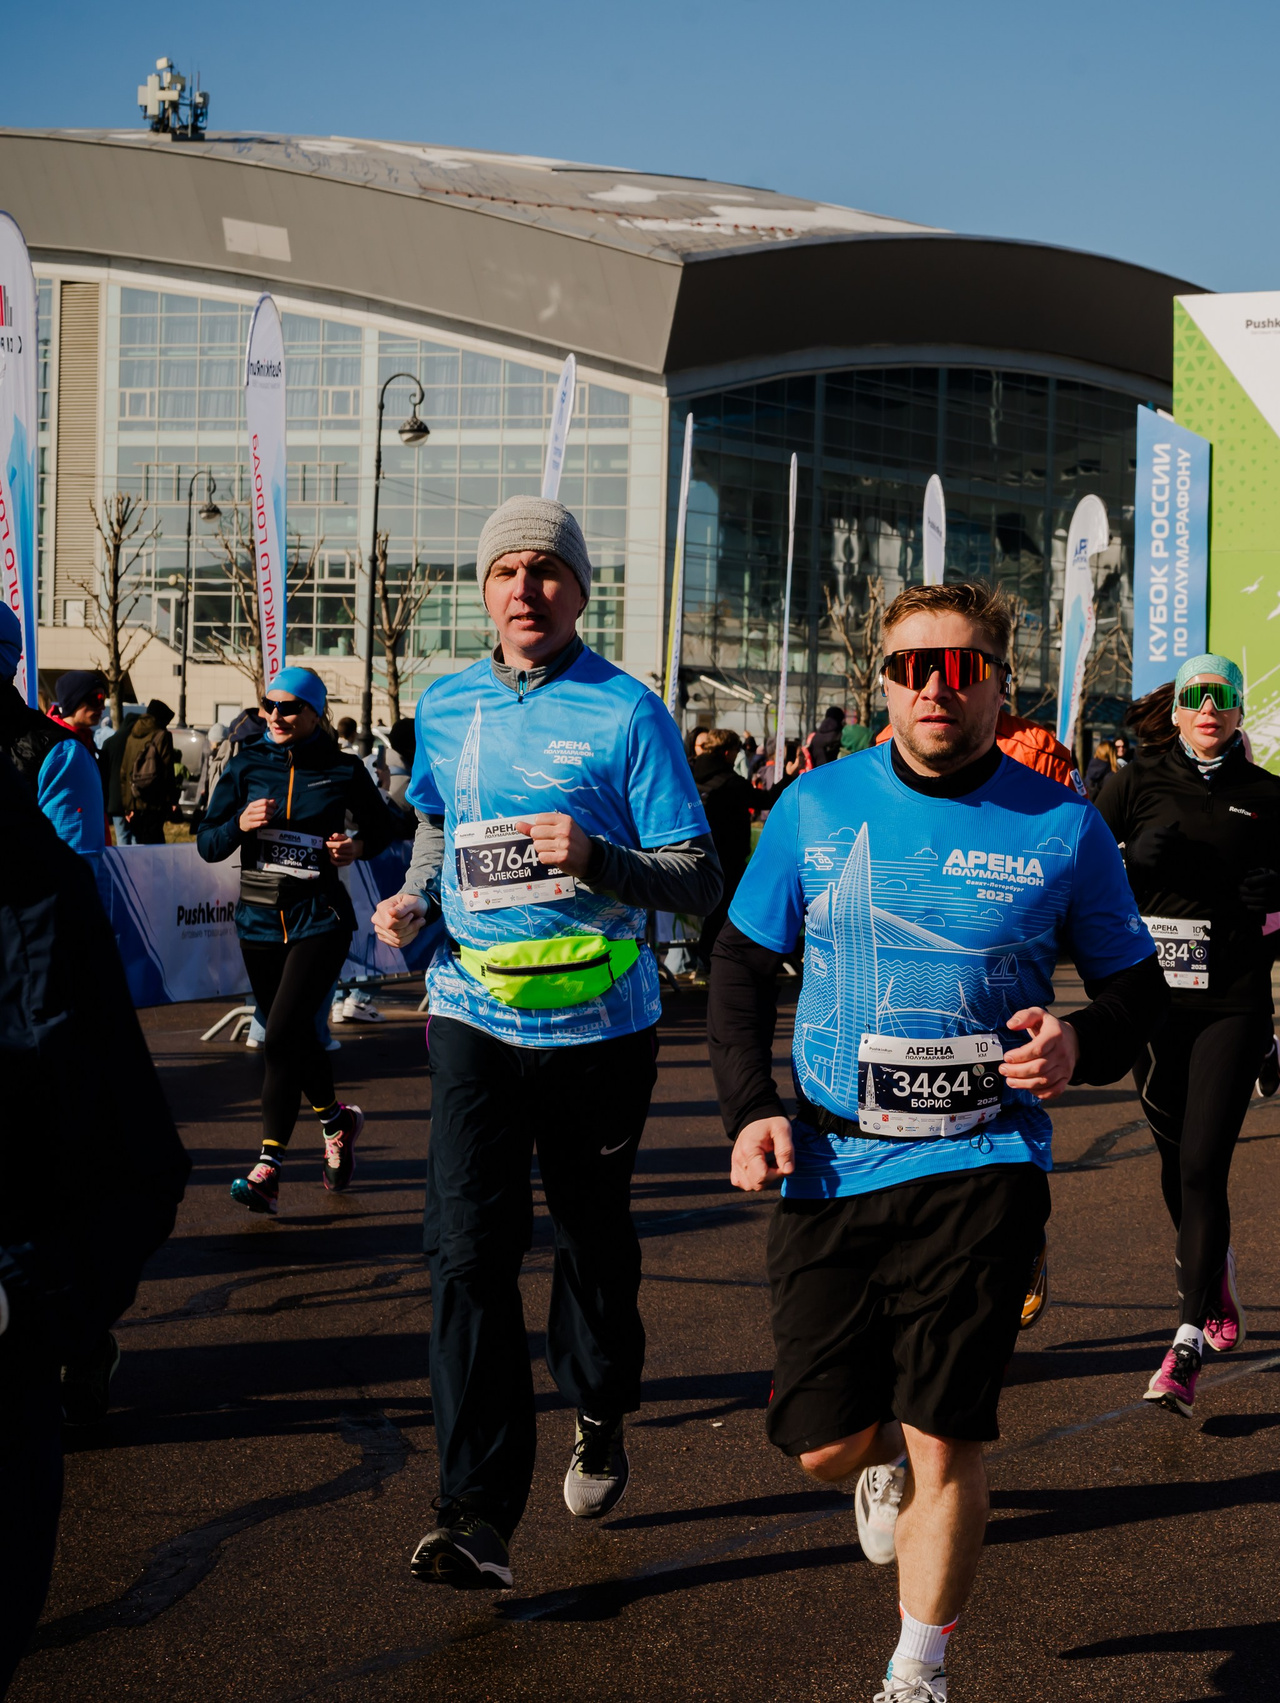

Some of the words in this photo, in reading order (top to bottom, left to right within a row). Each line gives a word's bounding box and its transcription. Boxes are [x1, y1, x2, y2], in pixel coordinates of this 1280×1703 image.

[1150, 443, 1172, 559] РОССИИ
[1173, 447, 1192, 624] ПОЛУМАРАФОНУ
[1148, 564, 1169, 663] КУБОК
[1173, 626, 1189, 658] ПО
[548, 740, 591, 751] АРЕНА
[553, 755, 582, 766] 2025
[271, 845, 307, 861] 3289
[479, 844, 539, 873] 3764
[944, 848, 1044, 877] АРЕНА
[489, 867, 531, 882] АЛЕКСЕЙ
[942, 866, 1045, 887] ПОЛУМАРАФОН
[965, 879, 1025, 893] Санкт-Петербург
[976, 888, 1014, 903] 2023
[177, 899, 235, 927] PushkinR
[1151, 924, 1178, 932] АРЕНА
[1155, 941, 1190, 961] 034
[1160, 960, 1176, 968] ЕСЯ
[906, 1046, 954, 1056] АРЕНА
[975, 1041, 989, 1053] 10
[892, 1071, 972, 1098] 3464
[911, 1098, 952, 1109] БОРИС
